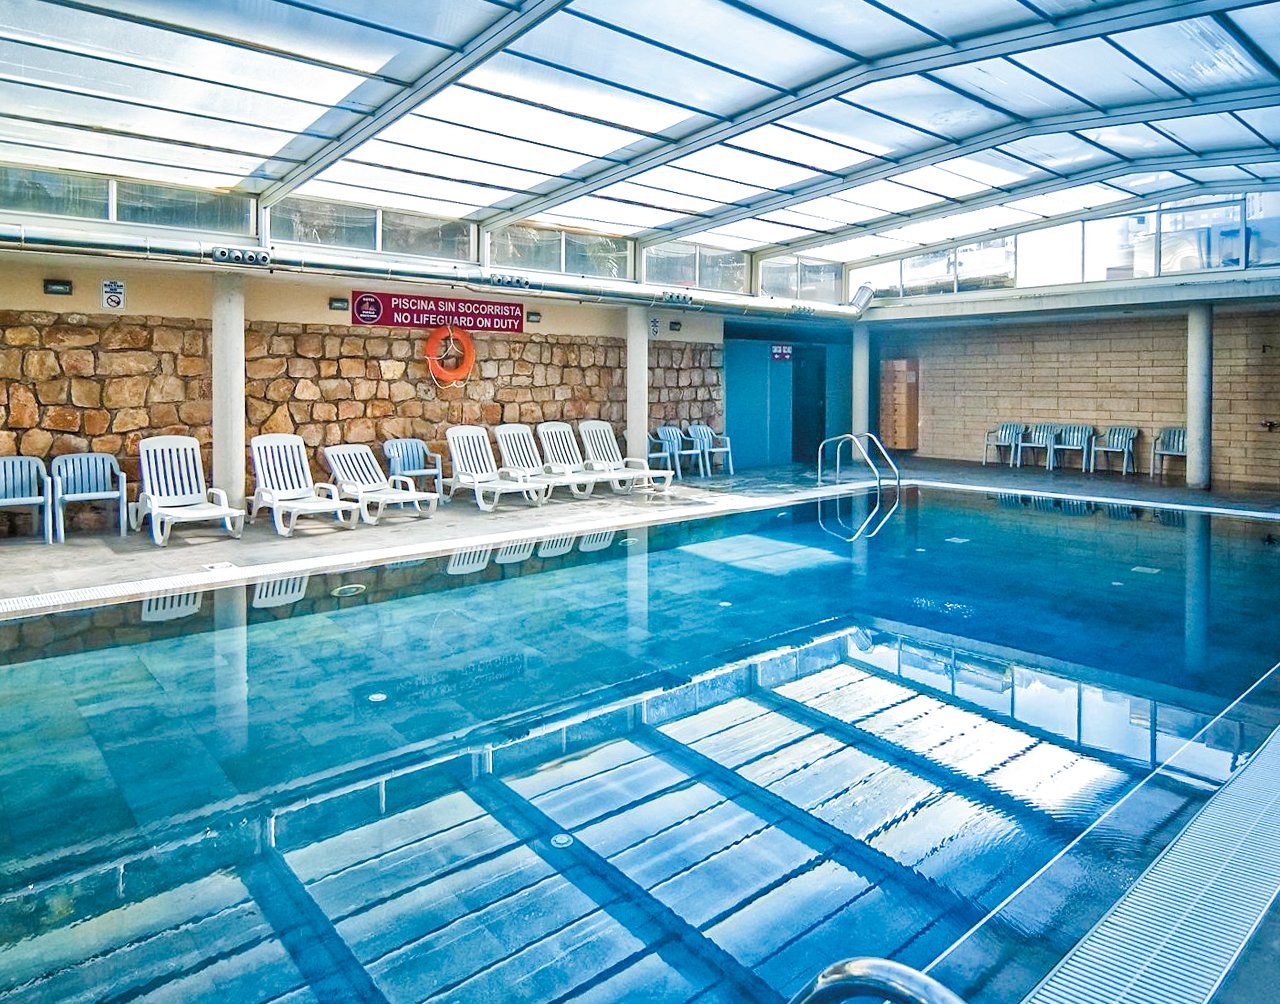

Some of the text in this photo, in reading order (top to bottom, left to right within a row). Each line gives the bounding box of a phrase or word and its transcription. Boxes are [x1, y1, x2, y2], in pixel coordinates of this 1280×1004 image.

[391, 297, 522, 316] PISCINA SIN SOCORRISTA
[394, 312, 520, 329] NO LIFEGUARD ON DUTY
